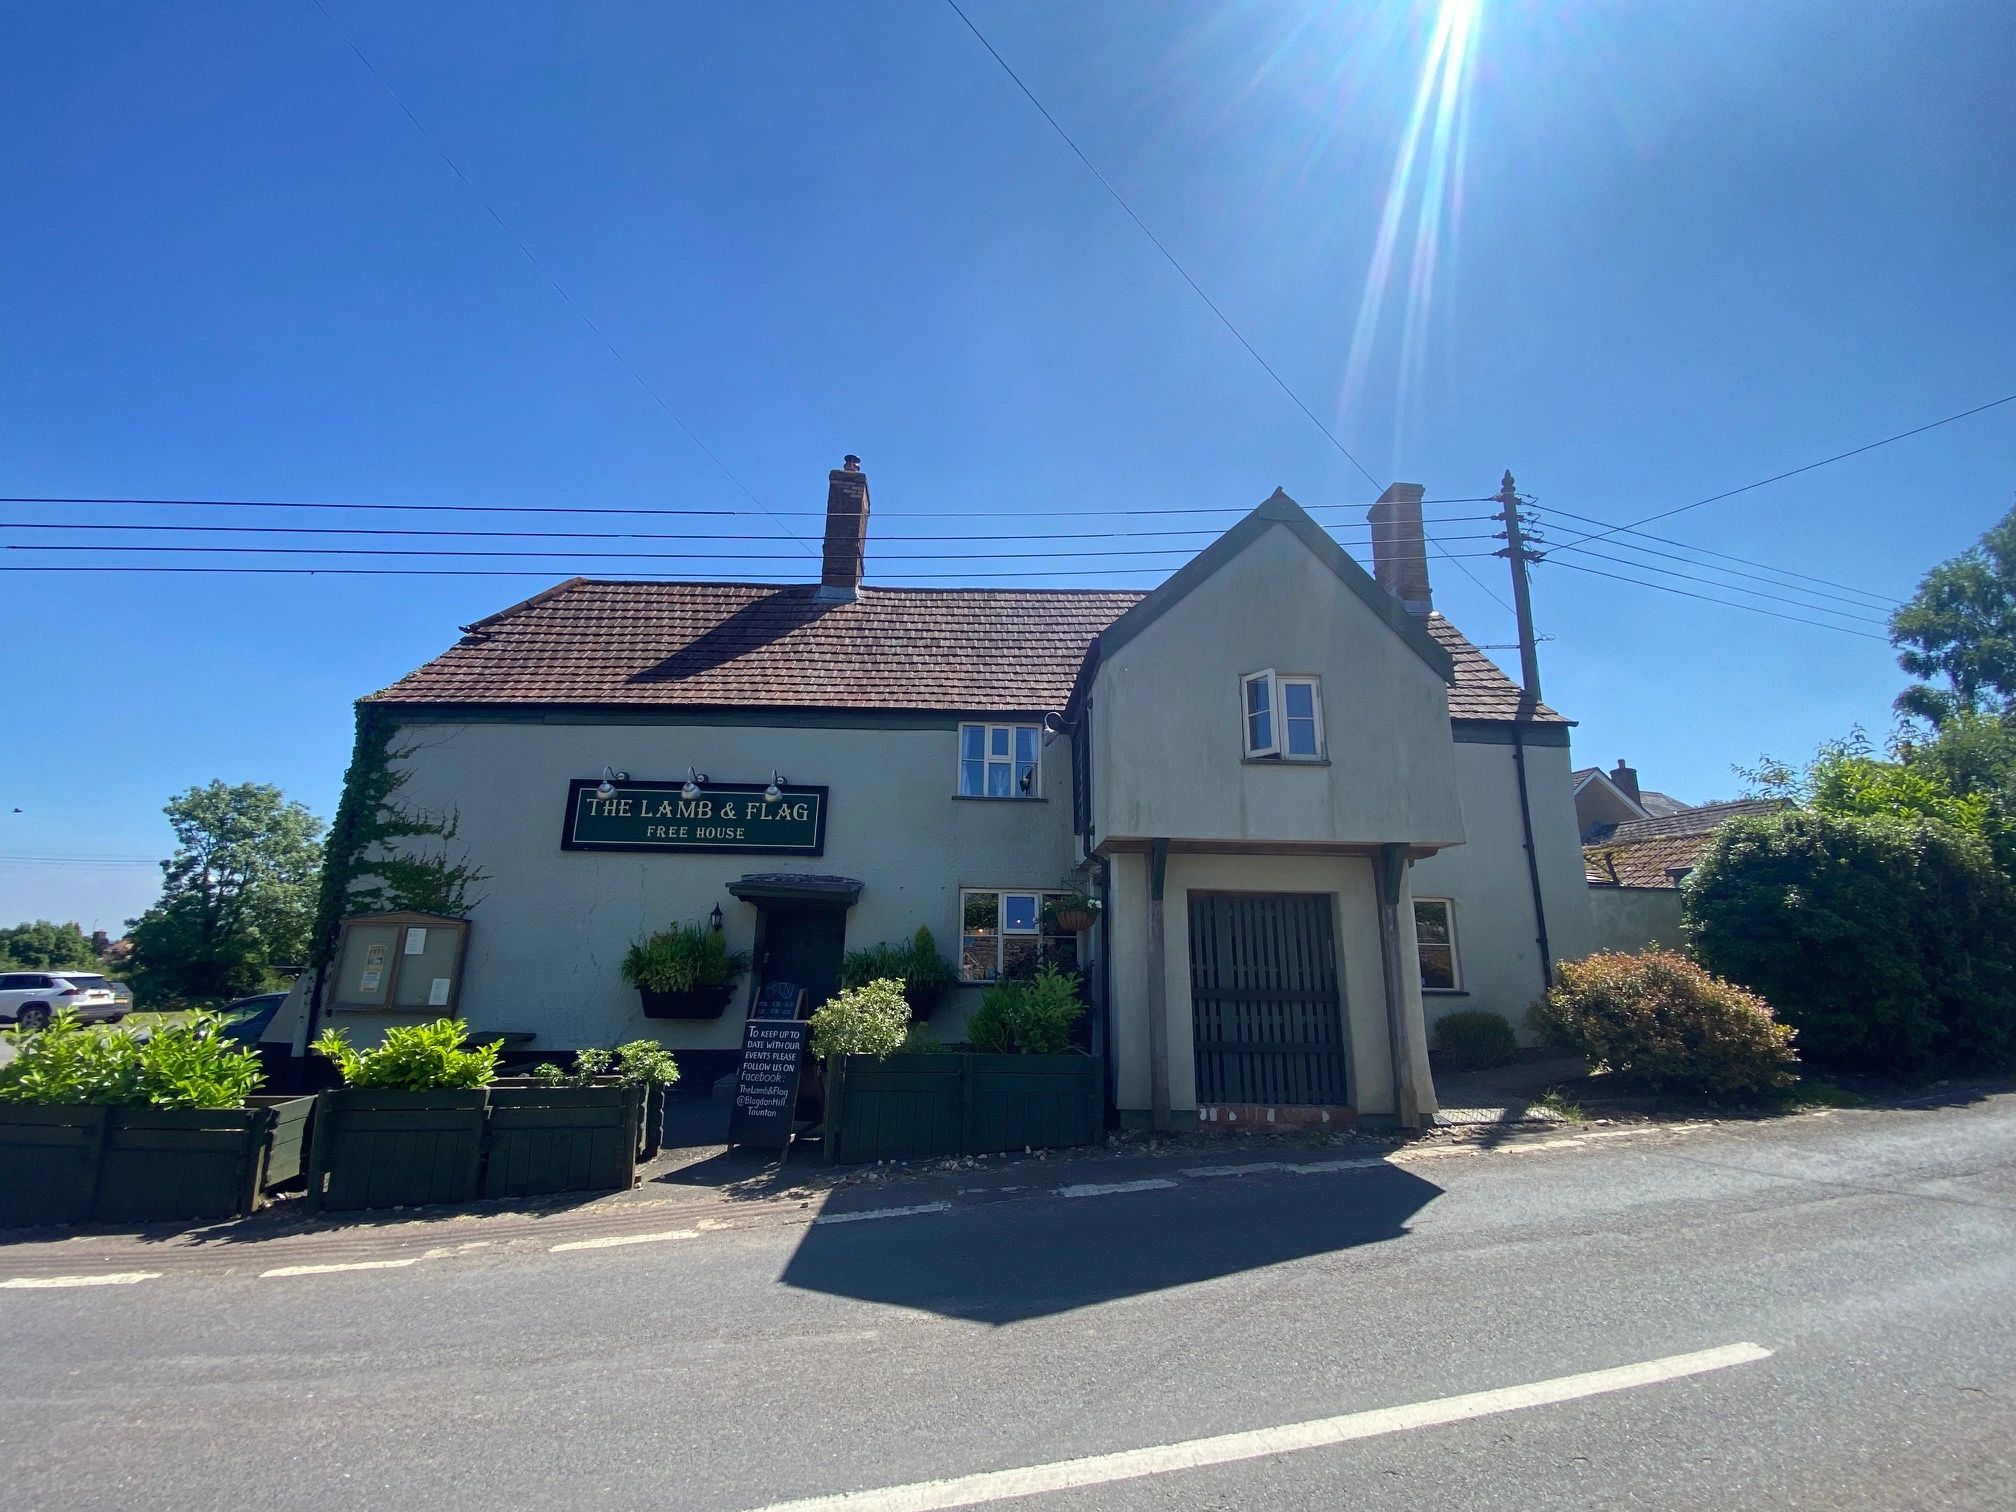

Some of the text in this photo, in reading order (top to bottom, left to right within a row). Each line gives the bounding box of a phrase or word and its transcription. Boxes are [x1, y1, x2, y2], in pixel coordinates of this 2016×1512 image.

[587, 799, 809, 821] THE LAMB & FLAG
[647, 825, 745, 839] FREE HOUSE
[760, 1030, 778, 1039] KEEP
[779, 1030, 789, 1039] UP
[789, 1031, 800, 1039] TO
[747, 1040, 764, 1049] DATE
[784, 1041, 800, 1050] OUR
[745, 1051, 796, 1061] EVENTS PLEASE
[743, 1062, 794, 1073] FOLLOW US ON
[747, 1106, 777, 1117] Taunton
